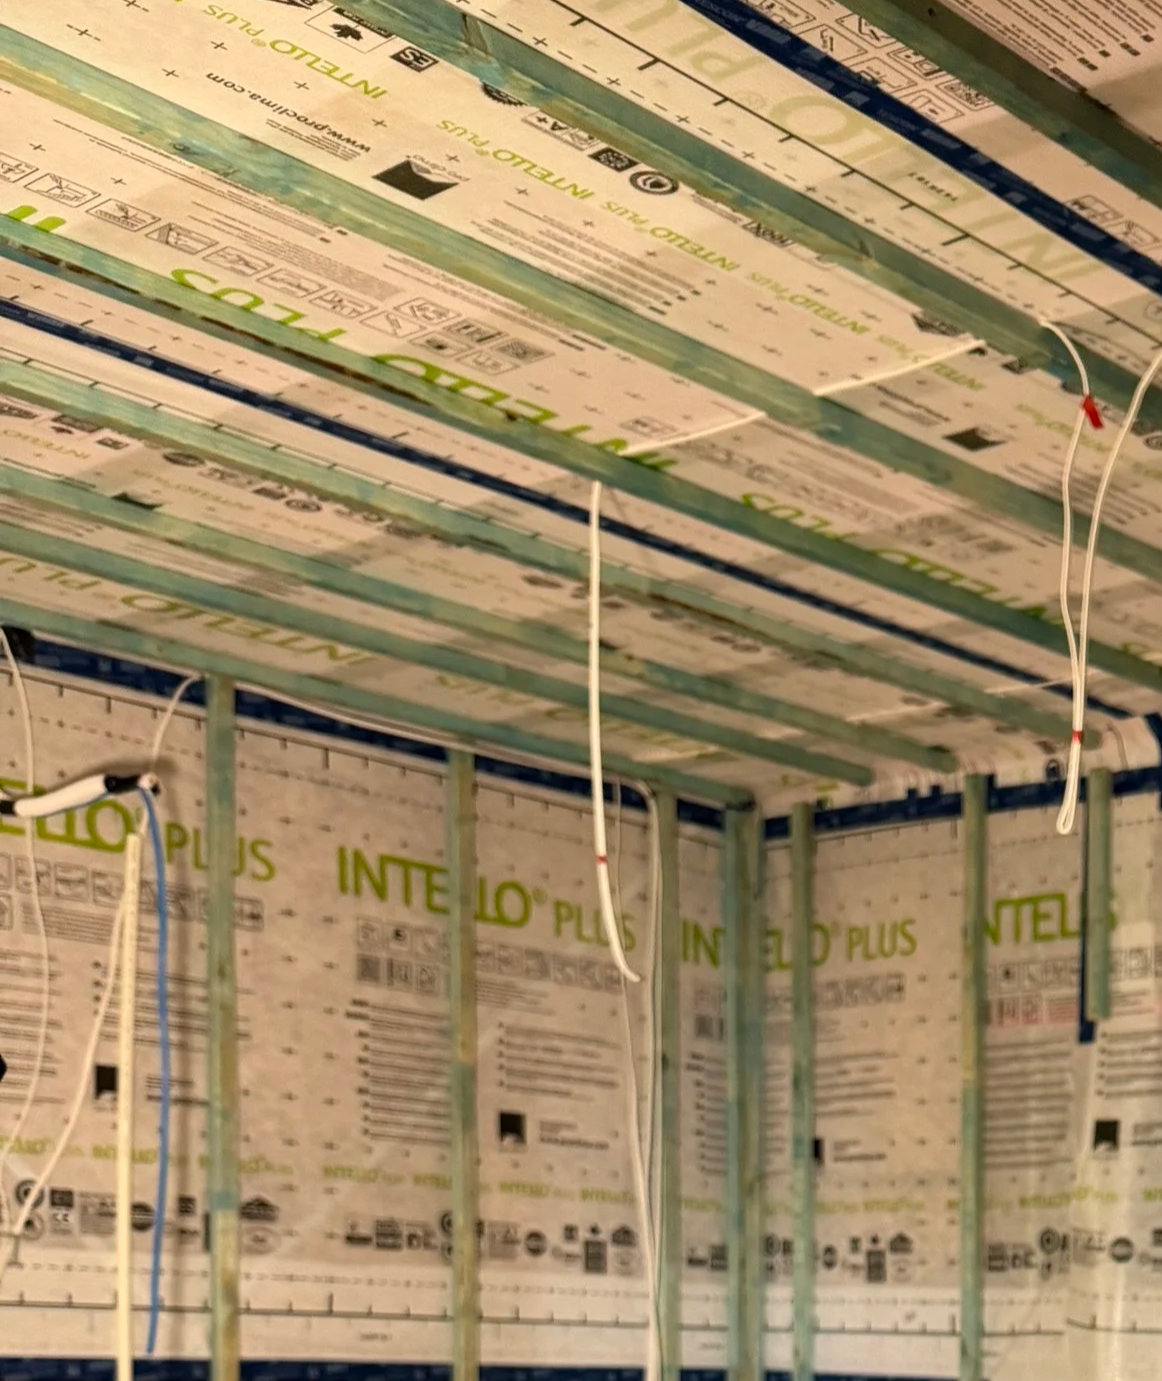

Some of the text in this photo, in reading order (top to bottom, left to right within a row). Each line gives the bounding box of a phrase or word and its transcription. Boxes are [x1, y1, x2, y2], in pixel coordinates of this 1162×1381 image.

[203, 4, 265, 37] PLUS
[206, 72, 372, 154] www.proclima.com
[436, 118, 490, 149] PLUS
[846, 918, 917, 963] PLUS
